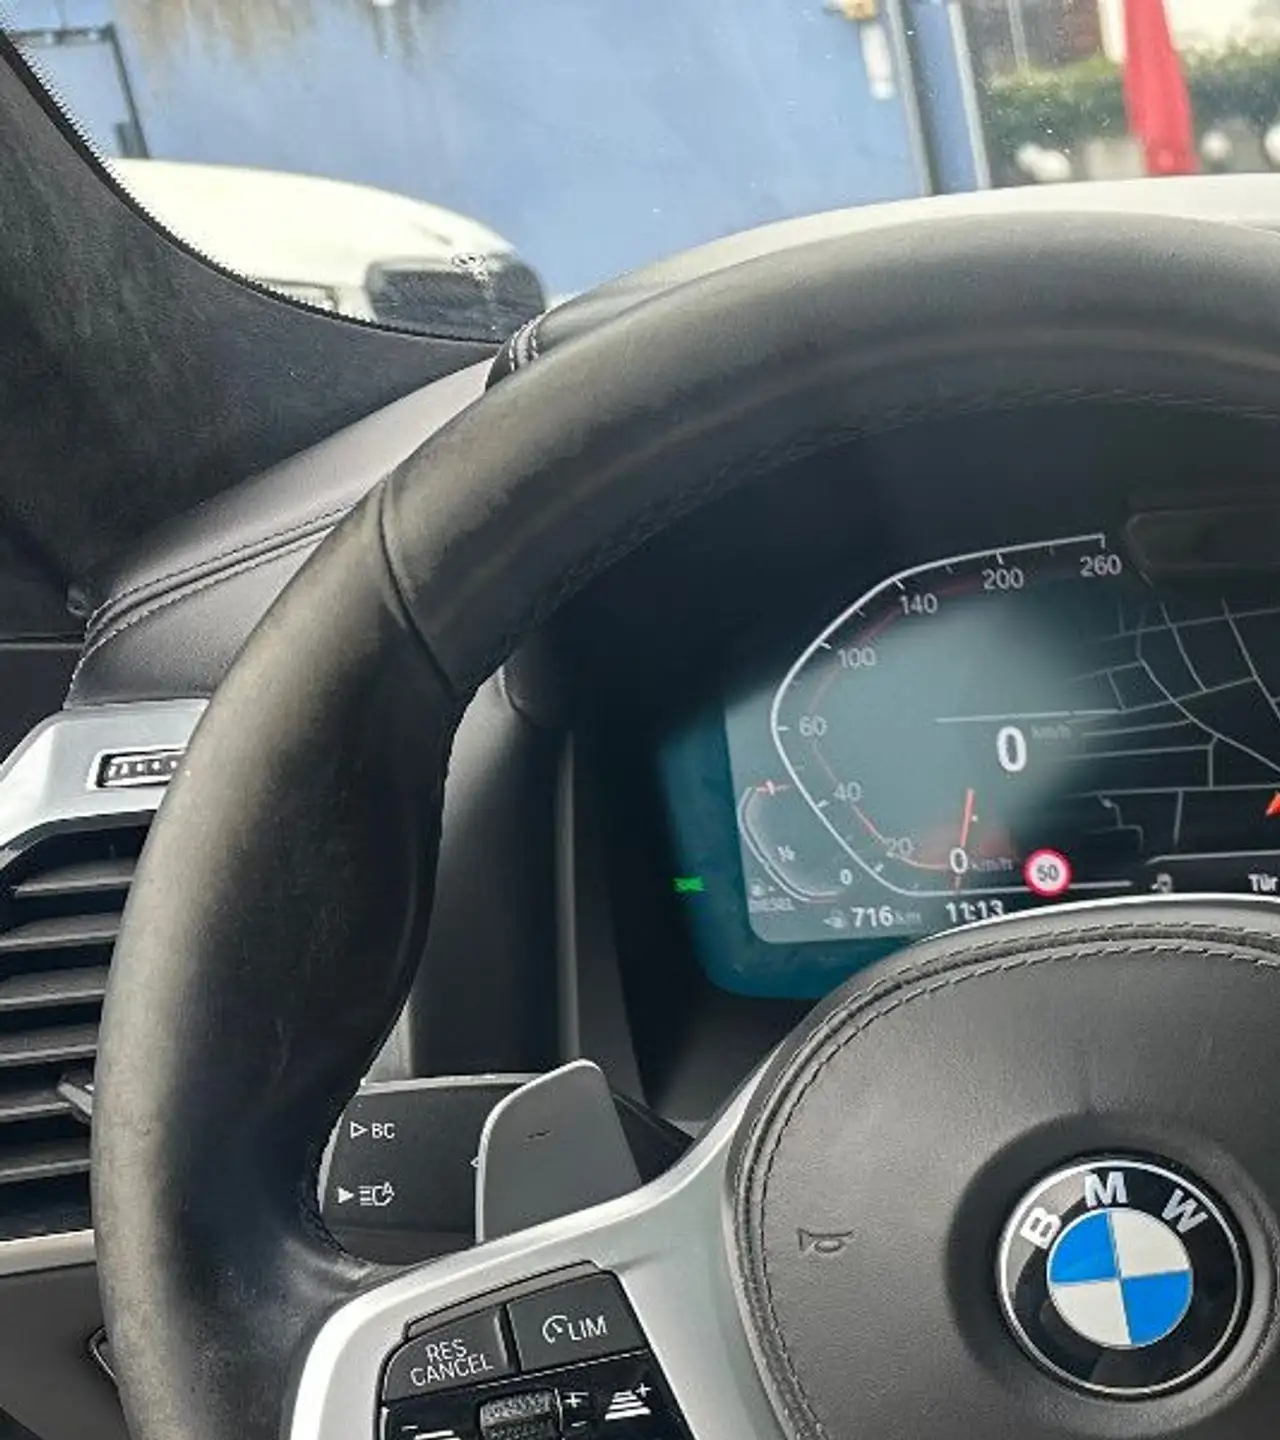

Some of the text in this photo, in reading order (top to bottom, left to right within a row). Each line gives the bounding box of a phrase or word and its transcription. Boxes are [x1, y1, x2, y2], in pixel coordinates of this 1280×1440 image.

[1079, 555, 1122, 577] 260
[982, 568, 1024, 591] 200
[900, 593, 938, 615] 140
[837, 647, 875, 669] 100
[799, 716, 827, 738] 60
[996, 725, 1027, 772] 0
[834, 781, 861, 802] 40
[885, 838, 914, 859] 20
[949, 847, 969, 875] 0
[839, 868, 853, 886] 0
[1036, 864, 1060, 883] 50
[851, 905, 894, 928] 716
[946, 899, 1004, 923] 11:13
[370, 1122, 397, 1140] BC
[1019, 1170, 1210, 1250] BMW
[567, 1315, 609, 1342] LIM
[424, 1338, 468, 1362] RES
[409, 1352, 495, 1387] CANCEL
